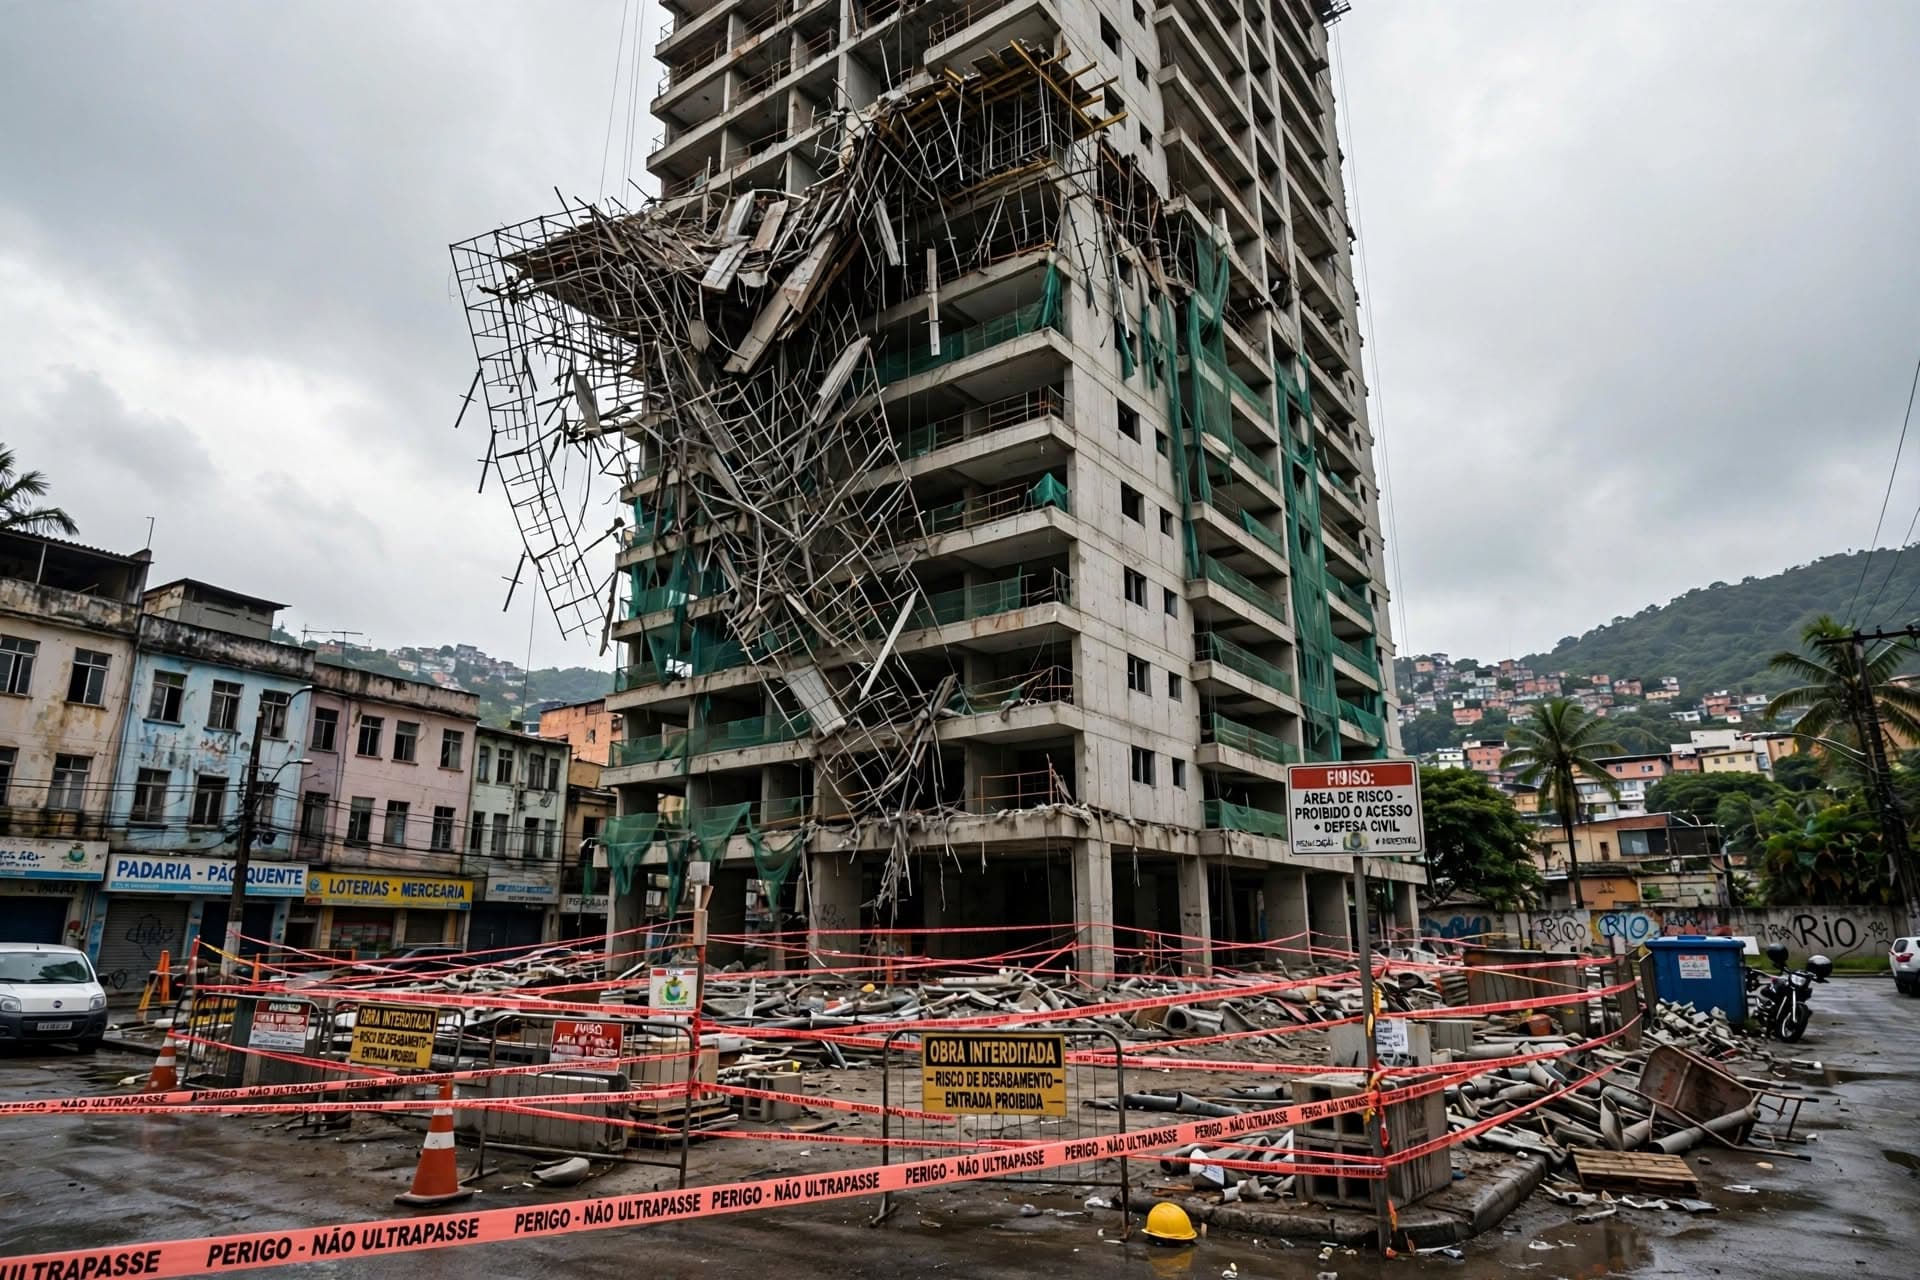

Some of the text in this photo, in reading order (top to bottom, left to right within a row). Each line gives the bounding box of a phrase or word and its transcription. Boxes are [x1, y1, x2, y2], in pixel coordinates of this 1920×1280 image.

[1303, 790, 1334, 805] ÁREA
[1338, 791, 1353, 804] DE
[1357, 790, 1393, 803] RISCO
[1295, 804, 1413, 820] PROIBIDO O ACESSO
[1324, 819, 1400, 833] DEFESA CIVIL
[116, 860, 191, 880] PADARIA
[245, 866, 303, 885] QUENTE
[329, 878, 465, 899] LOTERIAS MERCEARIA
[930, 1039, 966, 1063] OBRA
[970, 1040, 1057, 1064] INTERDITADA
[935, 1071, 1053, 1088] RISCO DE DESABAMENTO
[92, 1094, 168, 1107] ULTRAPASSE
[945, 1091, 1044, 1110] ENTRADA PROIBIDA
[1194, 1125, 1223, 1139] PERIGO
[1229, 1116, 1245, 1133] NÃO
[1246, 1110, 1289, 1130] ULTRAPASSE
[1065, 1141, 1099, 1161] PERIGO
[1106, 1135, 1125, 1153] NÃO
[1127, 1129, 1178, 1151] ULTRAPASSE
[905, 1163, 947, 1184] PERIGO
[957, 1156, 980, 1177] NÃO
[983, 1150, 1045, 1173] ULTRAPASSE
[712, 1186, 762, 1210] PERIGO
[774, 1179, 801, 1202] NÃO
[805, 1172, 880, 1198] ULTRAPASSE
[514, 1208, 571, 1233] PERIGO
[583, 1200, 614, 1225] NÃO
[618, 1193, 701, 1222] ULTRAPASSE
[206, 1236, 292, 1267] PERIGO
[311, 1227, 355, 1256] NÃO
[362, 1218, 480, 1250] ULTRAPASSE
[0, 1250, 162, 1280] ULTRAPASSE
